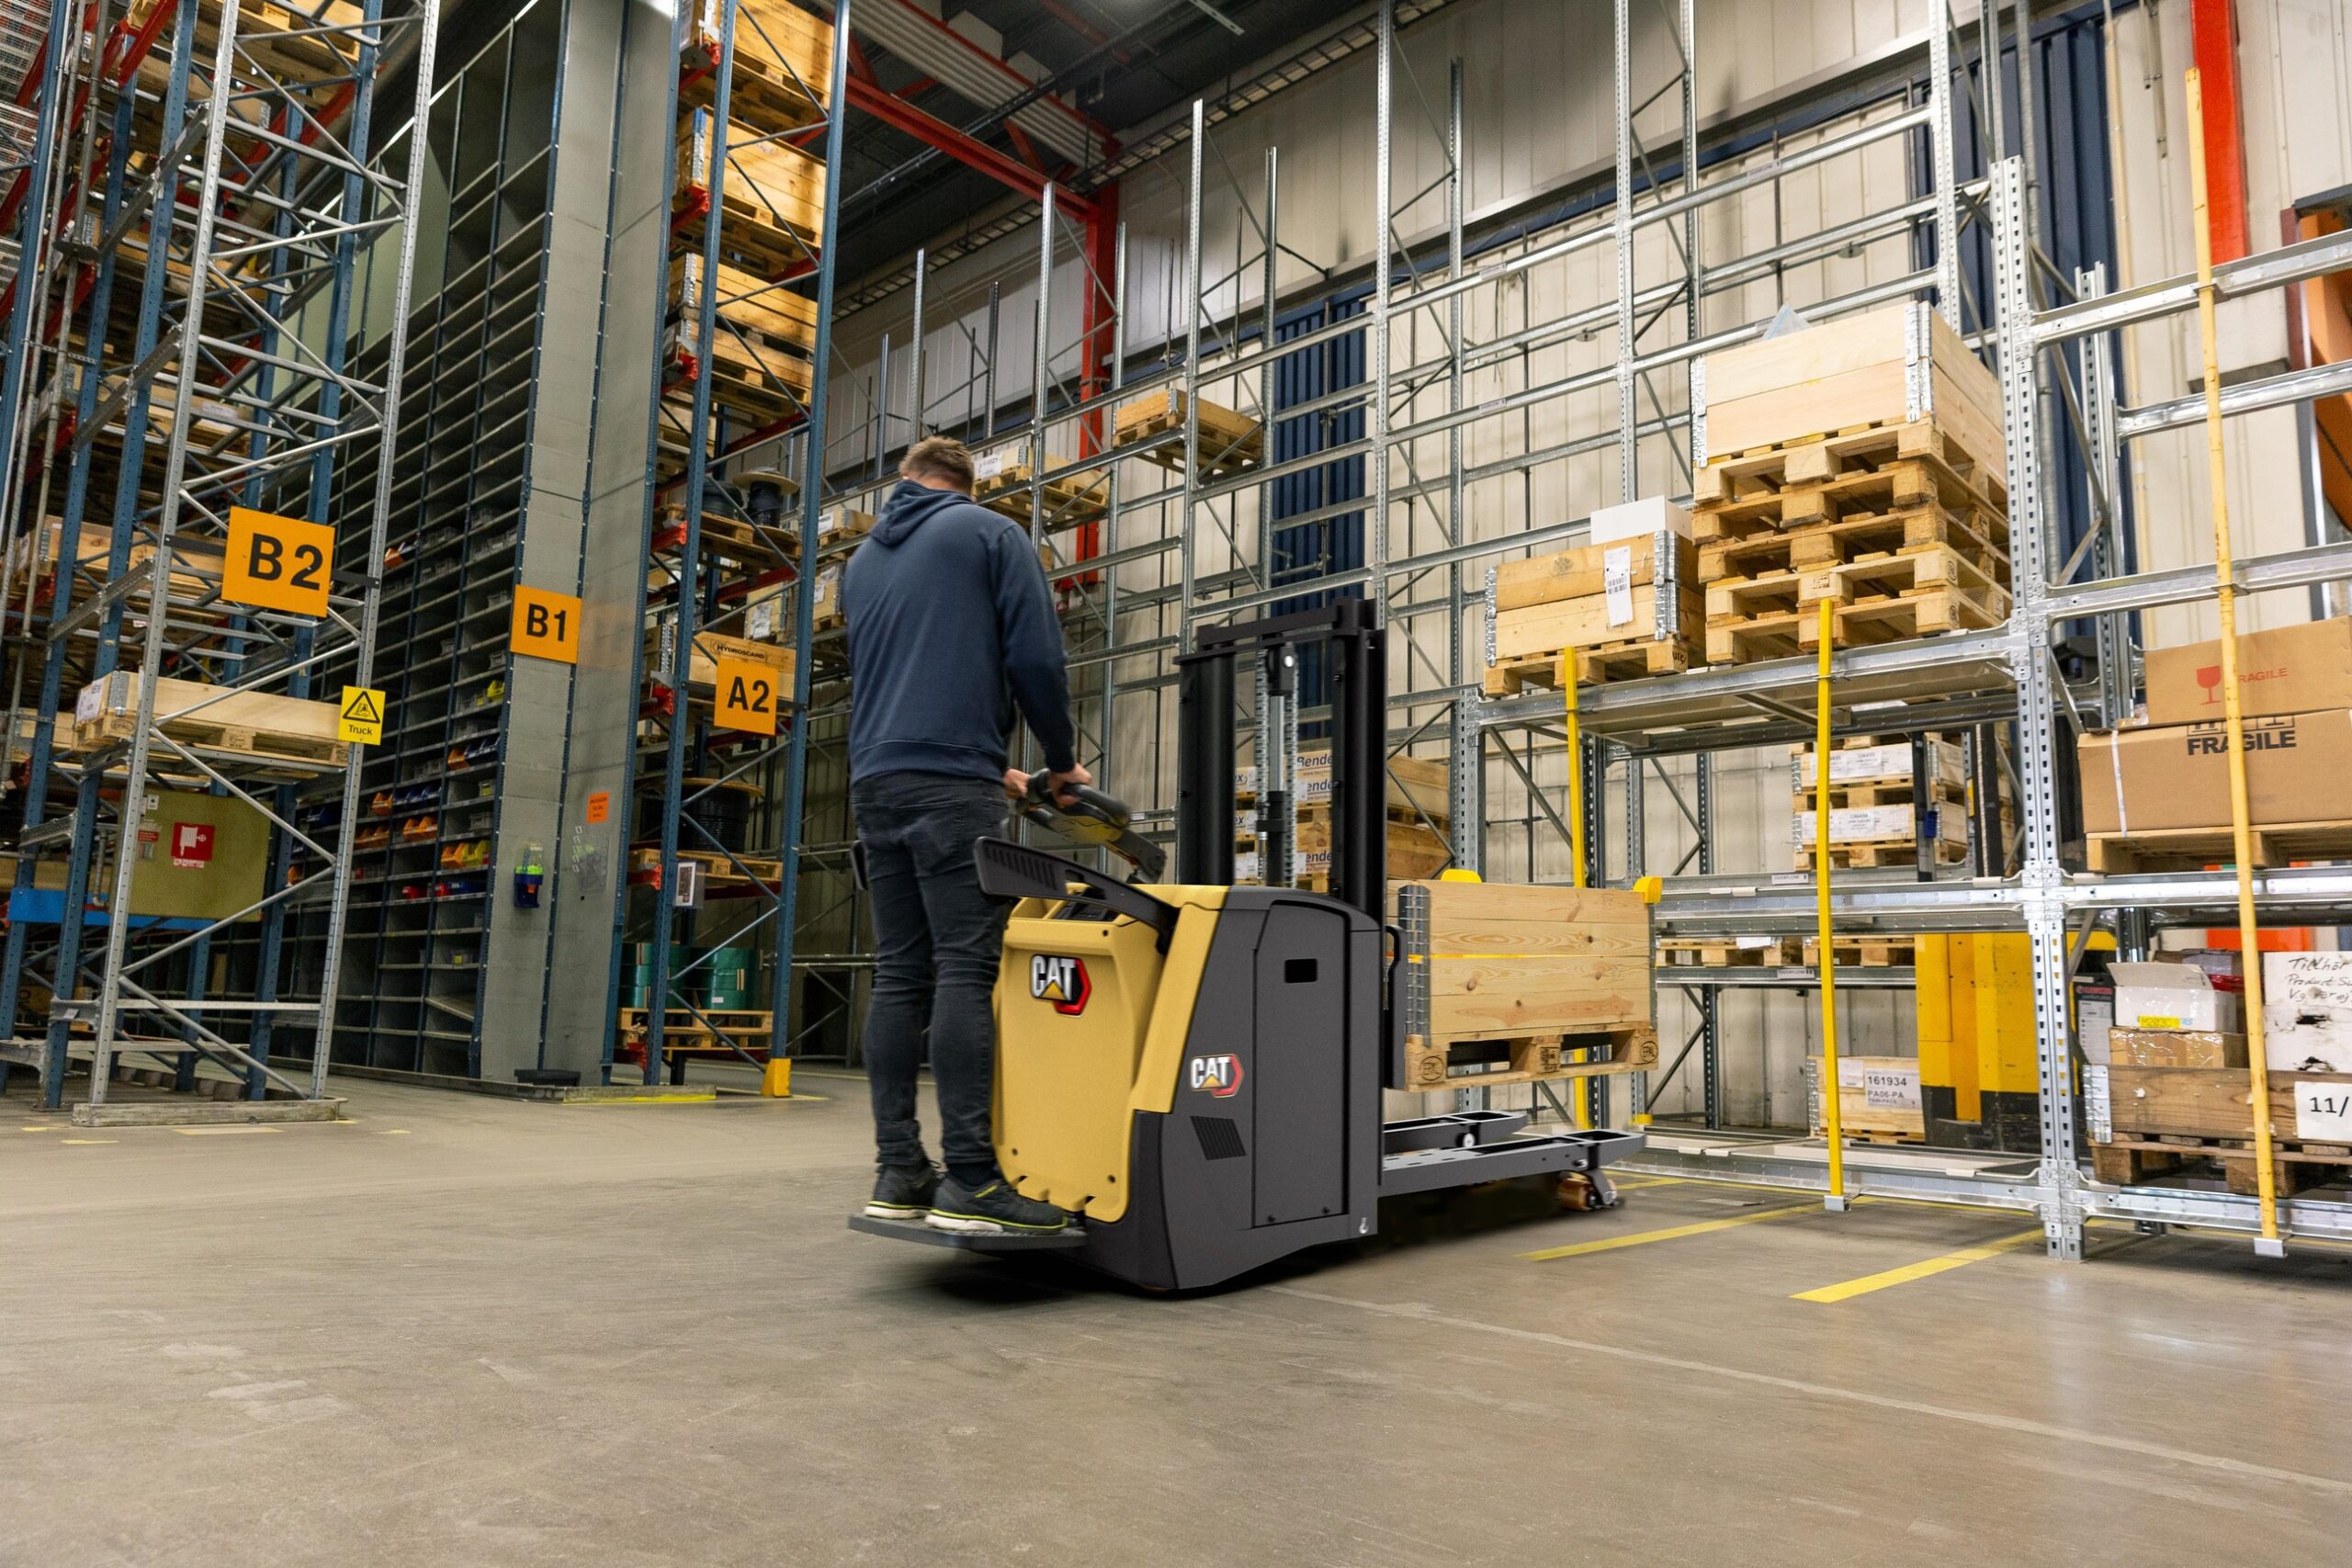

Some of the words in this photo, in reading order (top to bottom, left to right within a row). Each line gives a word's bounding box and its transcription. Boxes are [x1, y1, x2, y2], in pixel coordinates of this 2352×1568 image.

[248, 533, 322, 591] B2
[526, 603, 566, 642] B1
[2238, 668, 2289, 682] RAGILE
[727, 675, 770, 713] A2
[348, 724, 372, 736] Truck
[1296, 753, 1333, 767] Bende
[1306, 850, 1333, 863] ende
[1031, 955, 1077, 1001] CAT
[1191, 1056, 1231, 1089] CAT
[1867, 1076, 1908, 1087] 161934
